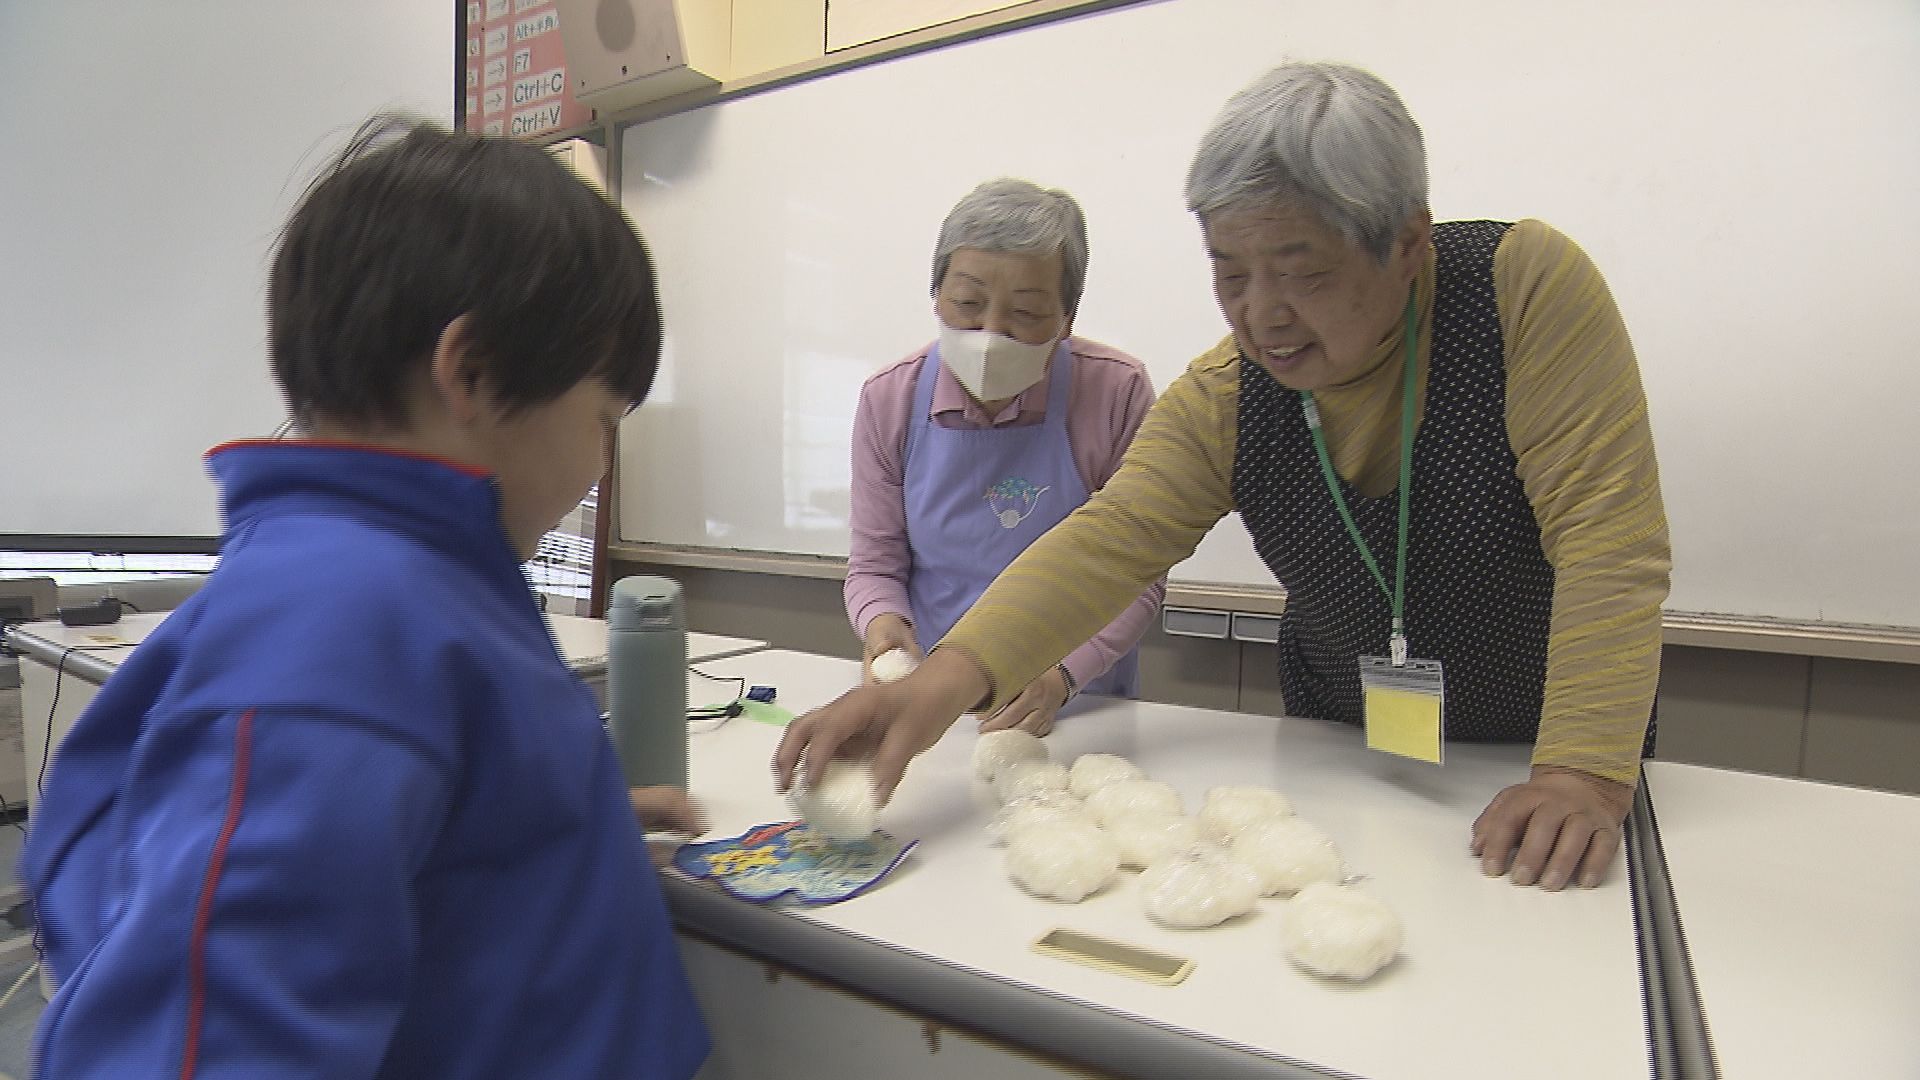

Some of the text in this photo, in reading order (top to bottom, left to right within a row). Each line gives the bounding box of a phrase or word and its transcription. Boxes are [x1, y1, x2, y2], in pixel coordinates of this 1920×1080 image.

[514, 54, 528, 73] F7
[514, 71, 562, 102] Ctrl+C
[511, 105, 560, 136] Ctrl+V
